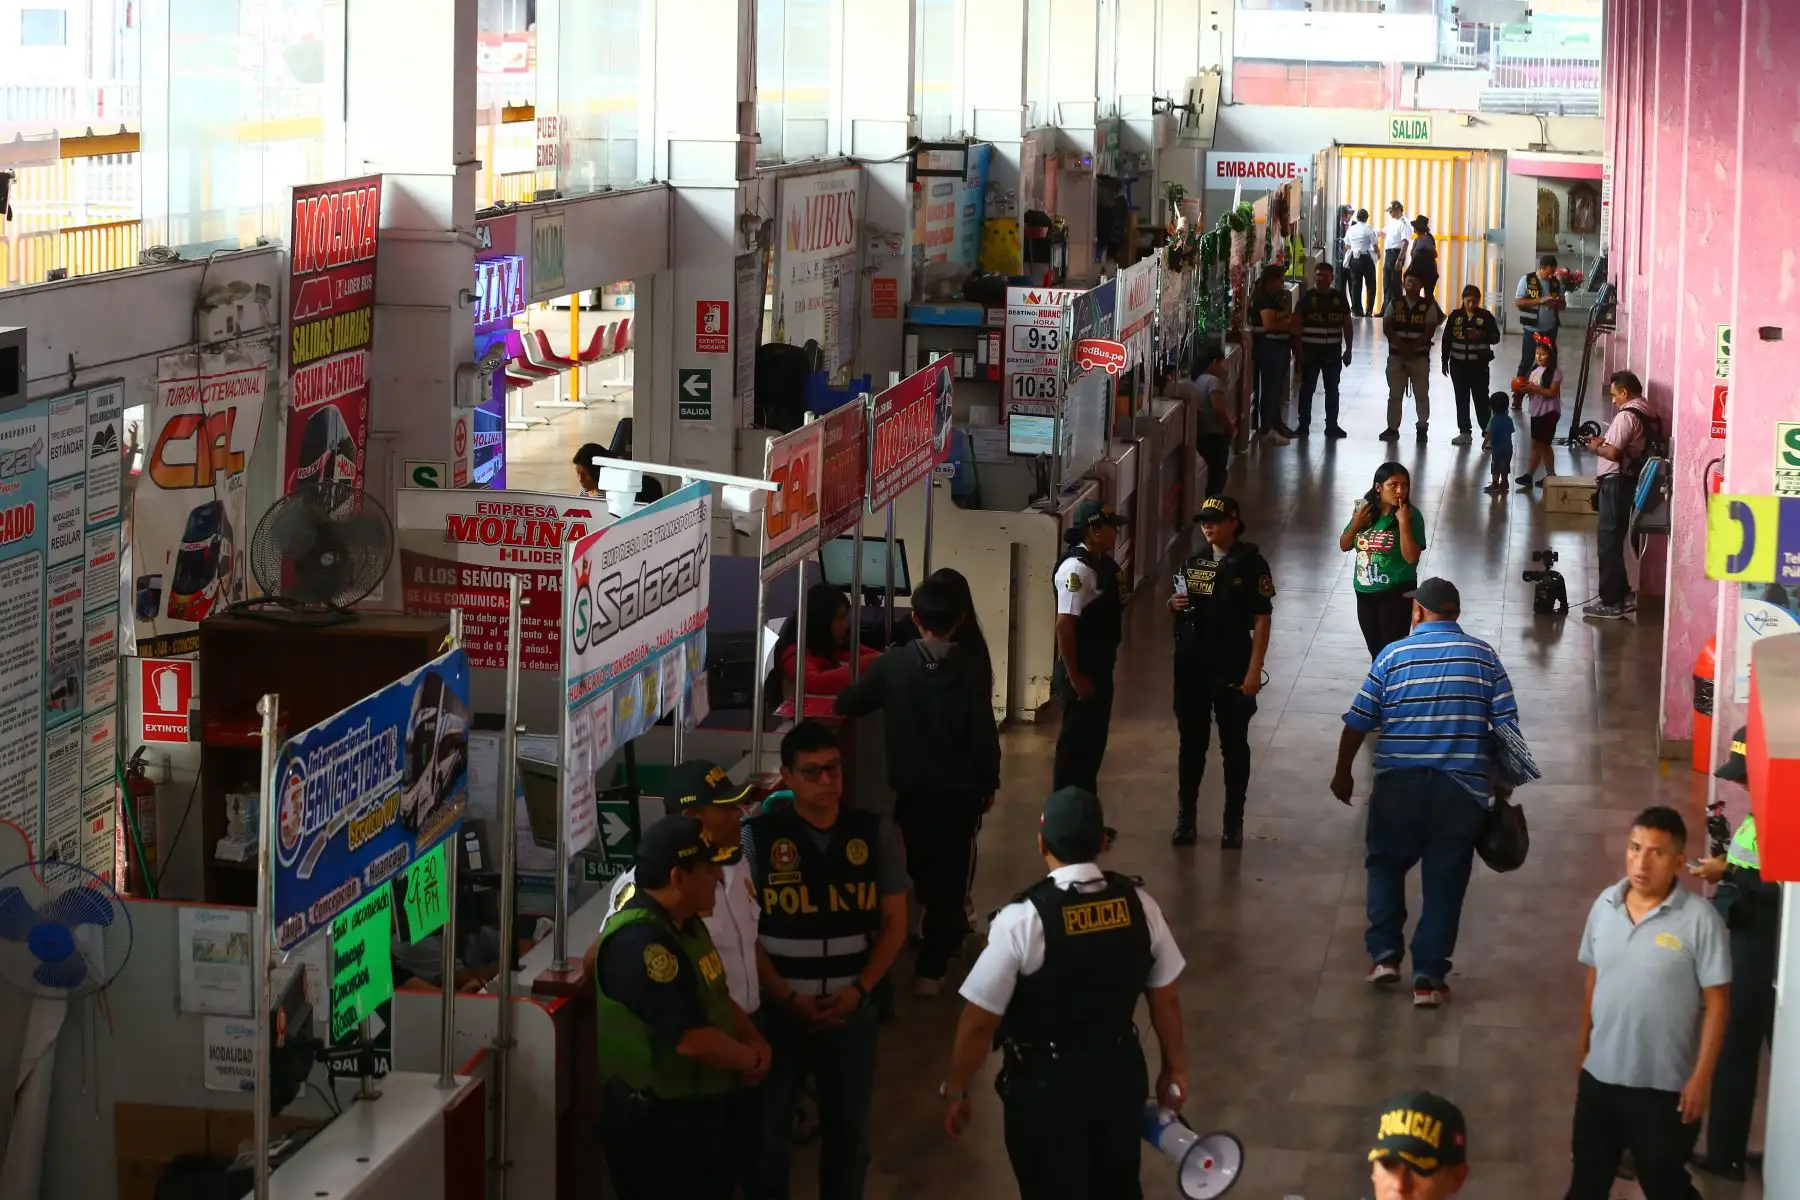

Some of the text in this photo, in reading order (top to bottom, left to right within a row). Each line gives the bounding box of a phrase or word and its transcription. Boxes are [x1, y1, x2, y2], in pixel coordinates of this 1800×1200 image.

[1392, 120, 1428, 140] SALIDA
[1217, 161, 1296, 178] EMBARQUE
[801, 189, 855, 253] MIBUS
[293, 187, 376, 275] MOLINA
[343, 278, 360, 296] LIDER
[705, 314, 714, 322] 27
[293, 306, 371, 365] SALIDAS DIARIAS
[1080, 346, 1124, 361] redBus.pe
[294, 353, 366, 405] SELVA CENTRAL
[1015, 375, 1056, 398] 10:3
[473, 432, 500, 447] MOLINA
[874, 392, 933, 480] MOLINA
[51, 439, 84, 459] ESTÁNDAR
[477, 502, 560, 518] EMPRESA
[51, 530, 81, 550] REGULAR
[446, 514, 588, 548] MOLINA
[520, 549, 562, 564] LIDER
[601, 541, 641, 570] EMPRESA
[641, 536, 653, 553] DE
[414, 567, 423, 583] A
[429, 567, 456, 585] LOS
[592, 532, 708, 647] Salazar
[407, 591, 509, 609] SE LES COMUNICA:
[476, 613, 497, 624] debe
[544, 619, 553, 627] su
[462, 625, 484, 636] (DNI)
[490, 627, 498, 636] al
[548, 630, 558, 640] de
[484, 641, 494, 651] de
[486, 657, 496, 667] de
[281, 847, 407, 943] Jauja Concepción Huancayo
[1065, 902, 1128, 932] POLICIA
[209, 1045, 253, 1064] MODALIDAD
